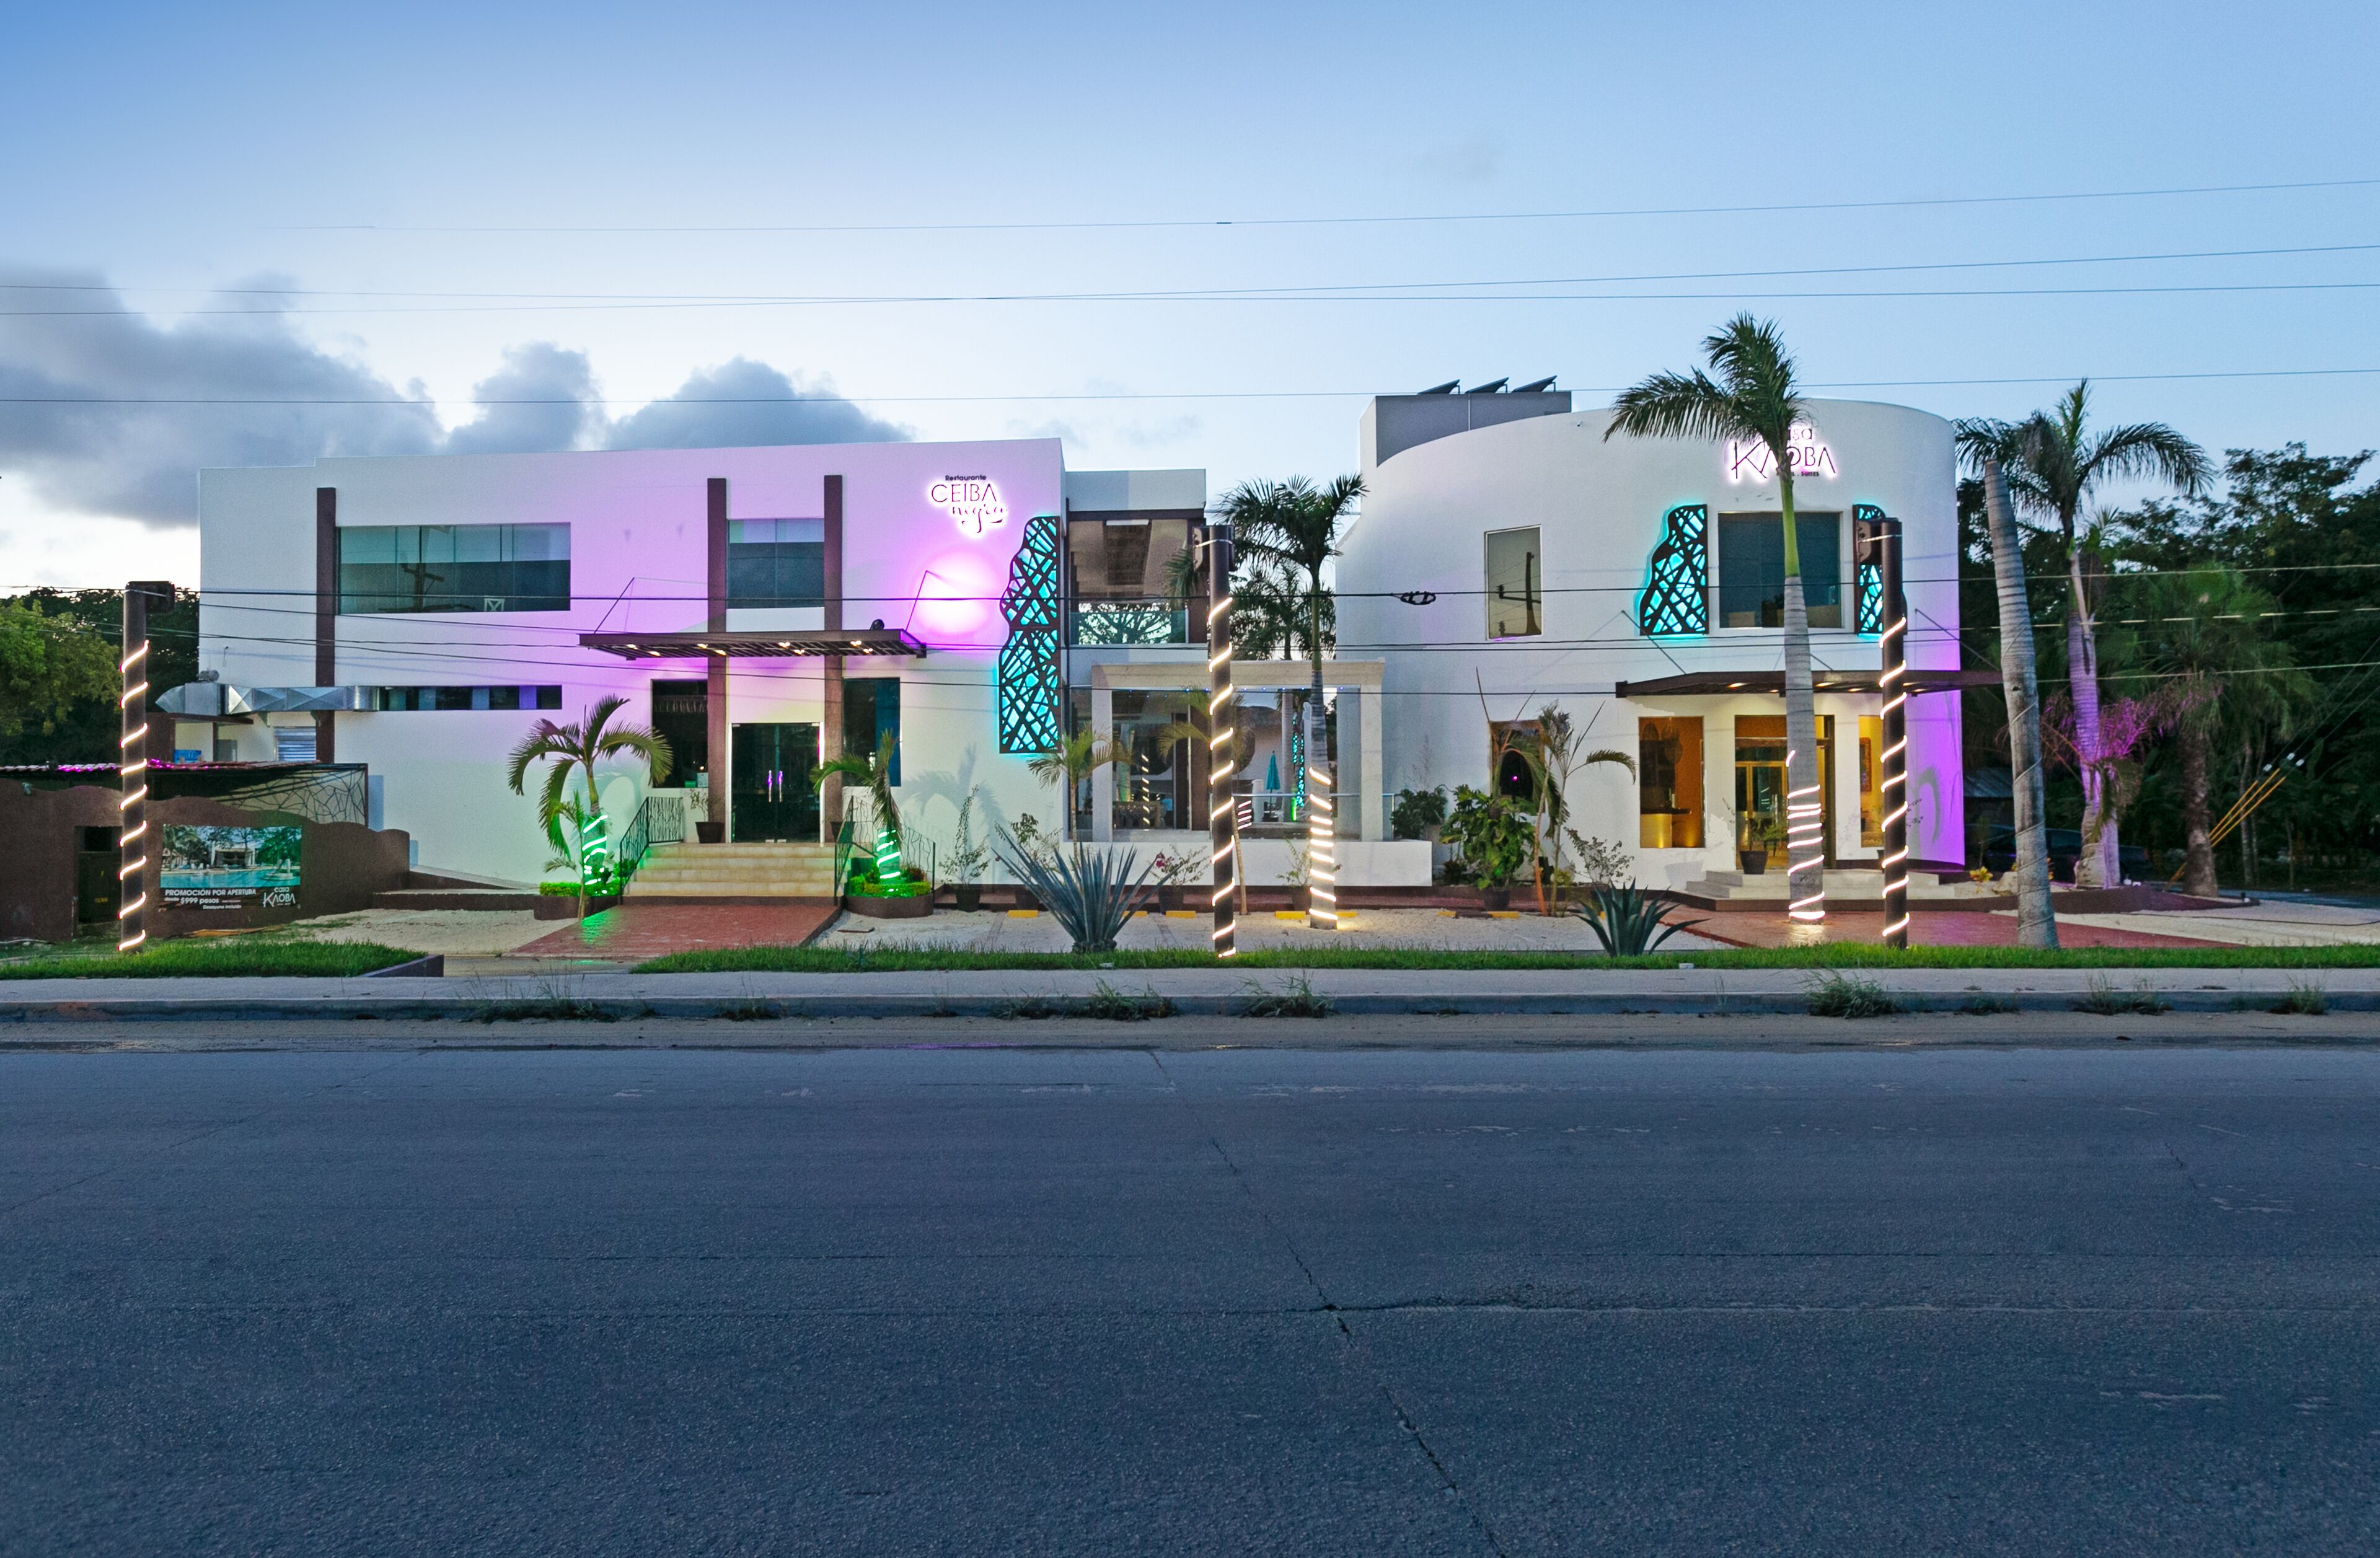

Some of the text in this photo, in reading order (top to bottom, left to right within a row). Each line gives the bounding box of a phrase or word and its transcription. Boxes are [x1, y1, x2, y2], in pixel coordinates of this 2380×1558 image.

[932, 483, 997, 503] CEIBA
[165, 888, 211, 896] PROMOCIÓN
[263, 892, 296, 908] KAOBA
